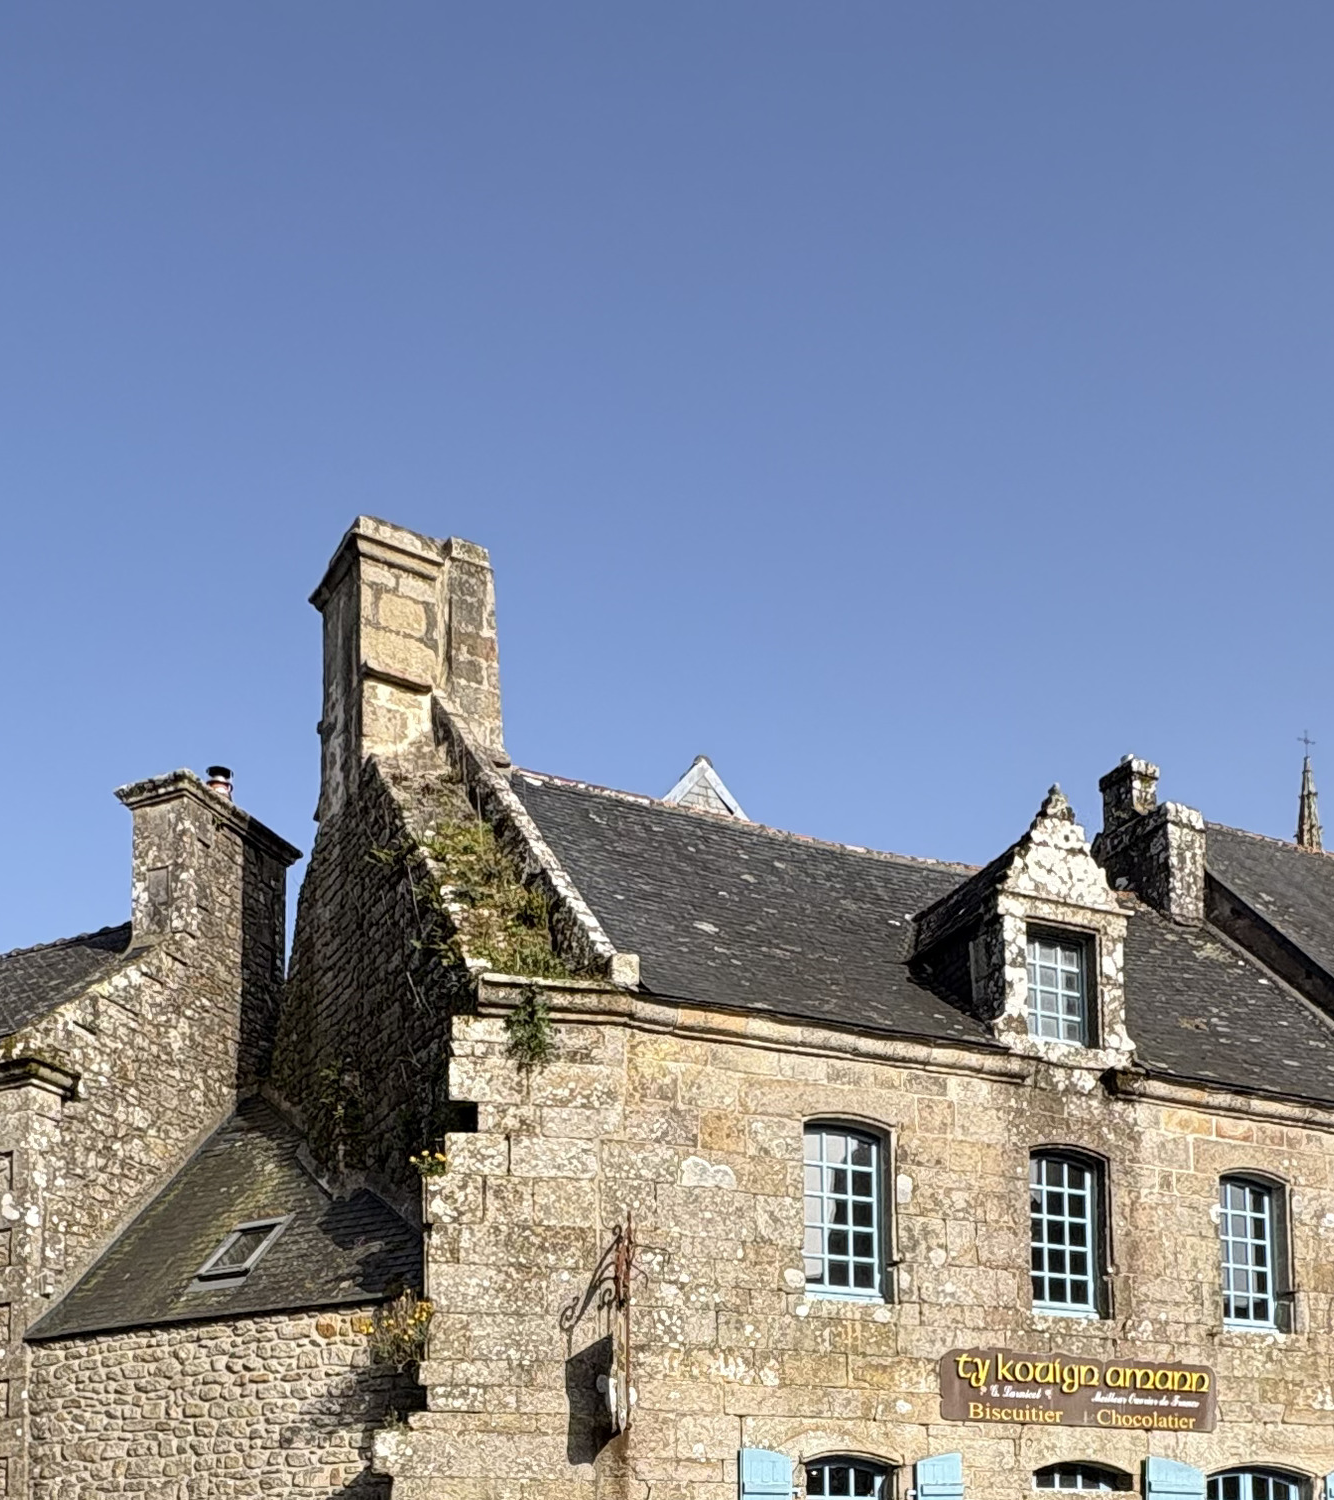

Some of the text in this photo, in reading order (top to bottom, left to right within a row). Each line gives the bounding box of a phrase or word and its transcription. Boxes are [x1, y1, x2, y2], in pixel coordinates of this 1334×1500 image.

[1105, 1366, 1210, 1393] amann
[968, 1402, 1064, 1423] Biscuitier
[1096, 1409, 1197, 1429] Chocolatier
